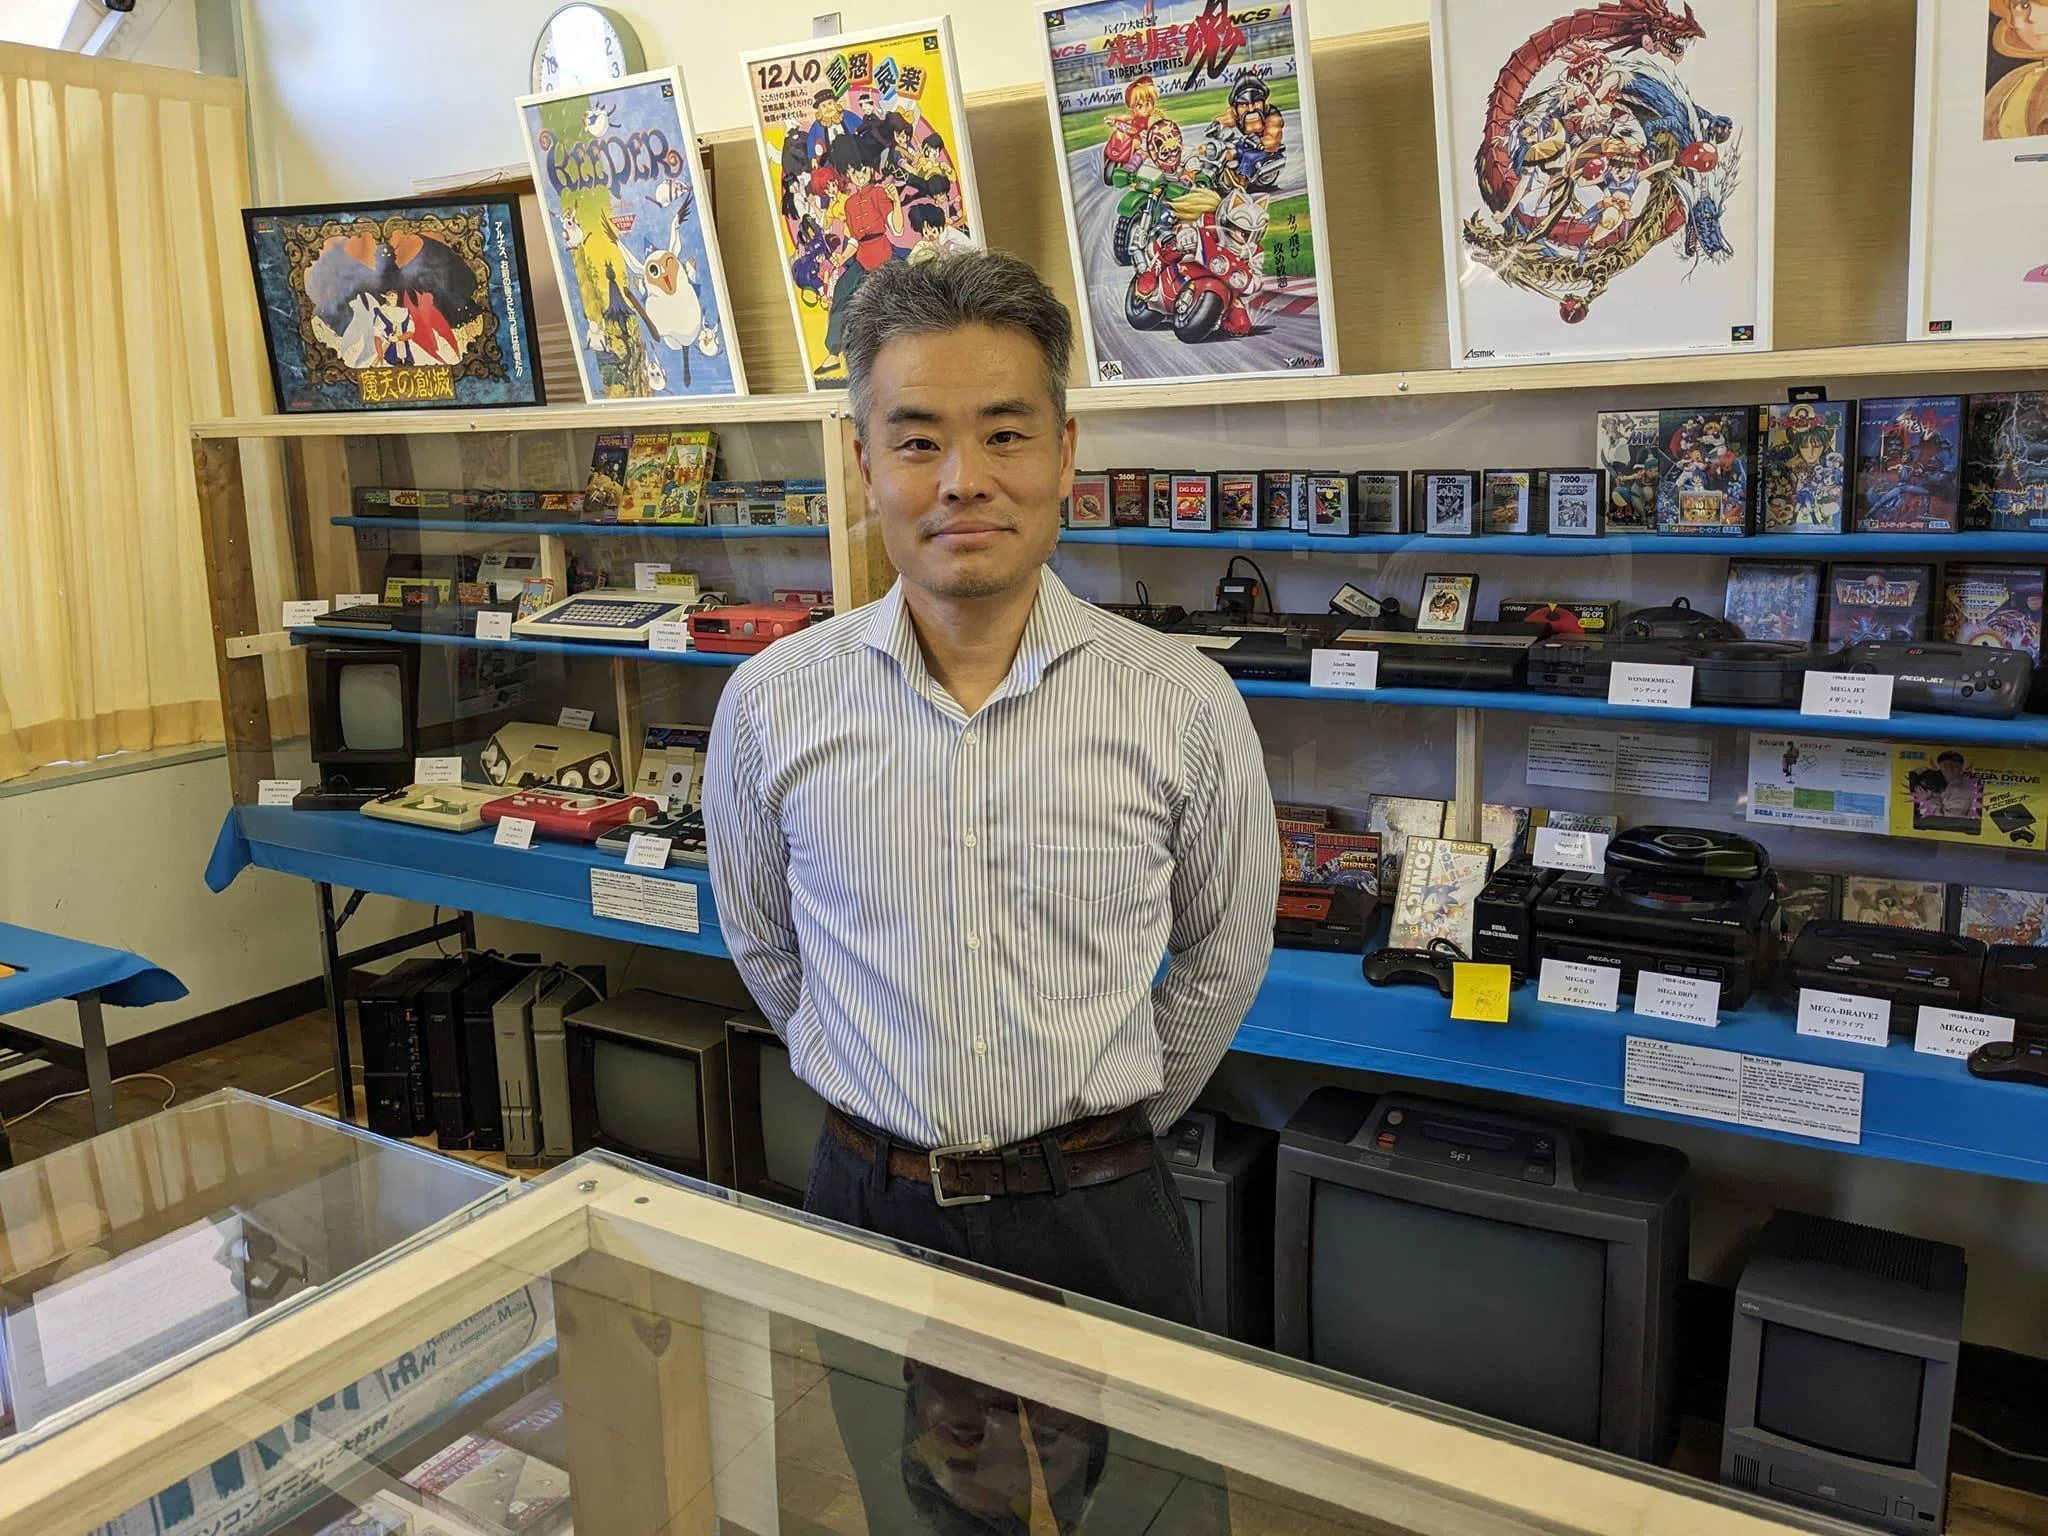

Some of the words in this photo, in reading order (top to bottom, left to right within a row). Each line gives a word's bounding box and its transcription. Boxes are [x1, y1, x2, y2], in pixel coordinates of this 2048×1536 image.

[757, 58, 821, 90] 12人の
[361, 368, 454, 401] 魔天の創滅
[1366, 476, 1384, 484] 7800
[1436, 476, 1456, 484] 7800
[1559, 475, 1580, 483] 7800
[1565, 975, 1595, 985] MEGA-CD
[1657, 987, 1677, 997] MEGA
[1677, 989, 1699, 999] DRIVE
[1809, 1003, 1879, 1020] MEGA-DRAIVE2
[1823, 1017, 1864, 1029] メガドライブ2
[1940, 1023, 1990, 1038] MEGA-CD2
